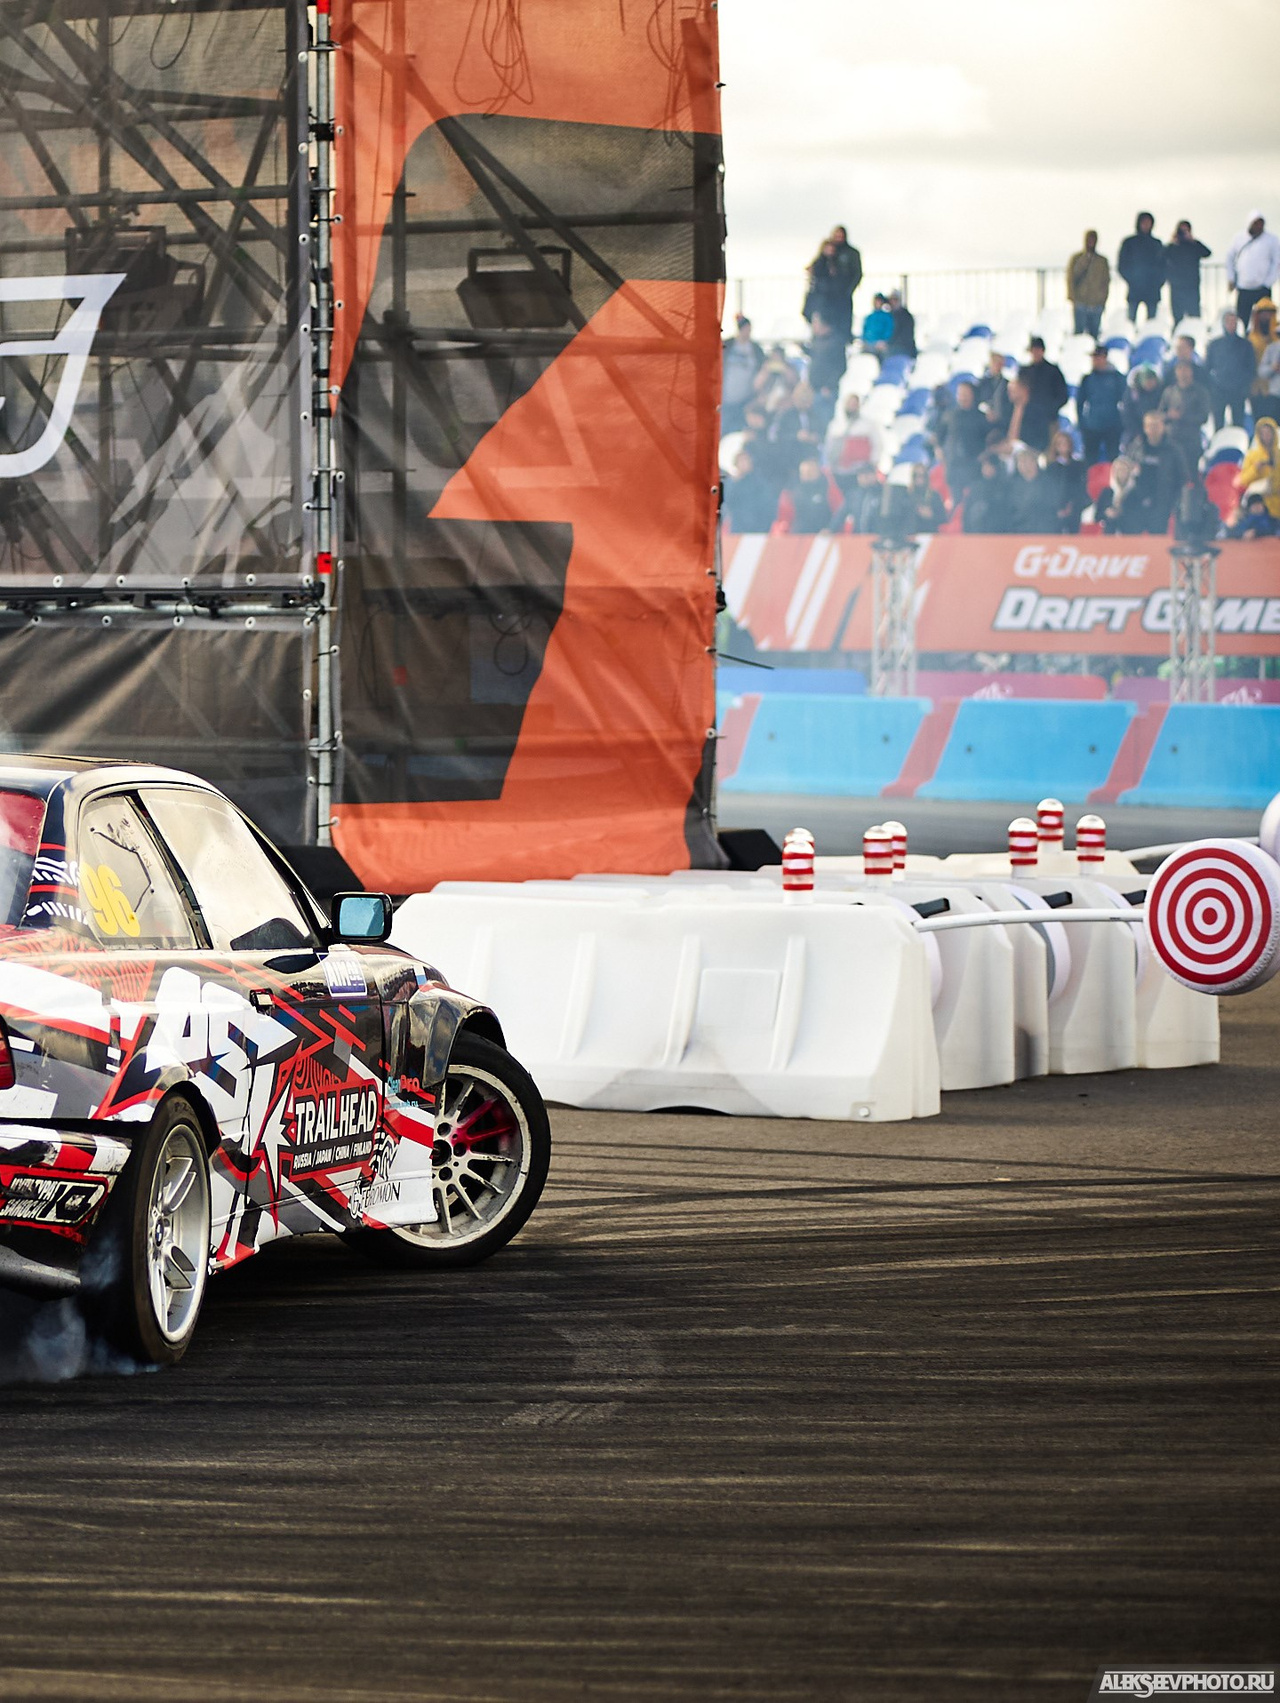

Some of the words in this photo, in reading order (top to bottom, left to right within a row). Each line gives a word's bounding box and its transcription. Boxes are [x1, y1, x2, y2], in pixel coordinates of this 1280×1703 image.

[991, 585, 1147, 633] DRIFT
[295, 1090, 377, 1146] TRAILHEAD
[293, 1152, 312, 1170] RUSSIA
